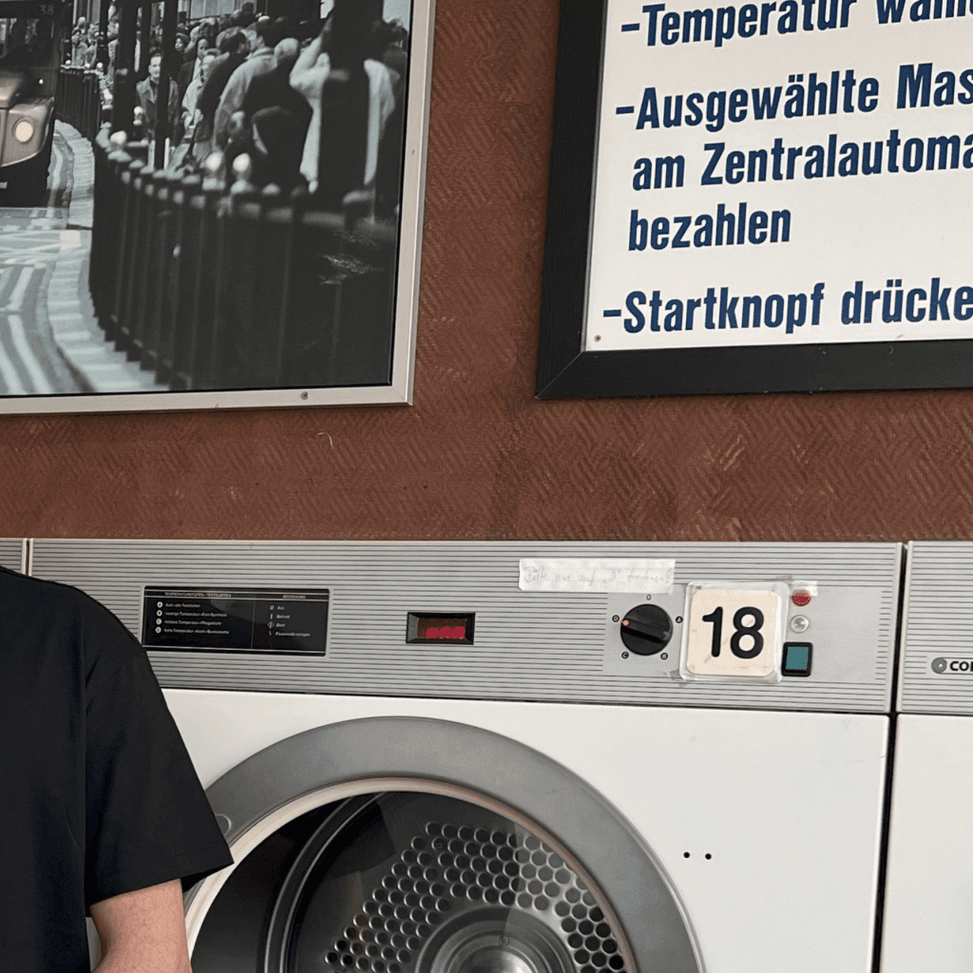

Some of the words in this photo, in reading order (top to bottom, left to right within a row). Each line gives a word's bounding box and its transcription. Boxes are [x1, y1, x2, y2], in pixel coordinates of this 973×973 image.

[615, 70, 880, 133] -Ausgewählte
[632, 155, 685, 191] am
[628, 202, 791, 252] bezahlen
[603, 282, 825, 334] -Startknopf
[841, 277, 973, 325] drücke
[703, 606, 766, 660] 18
